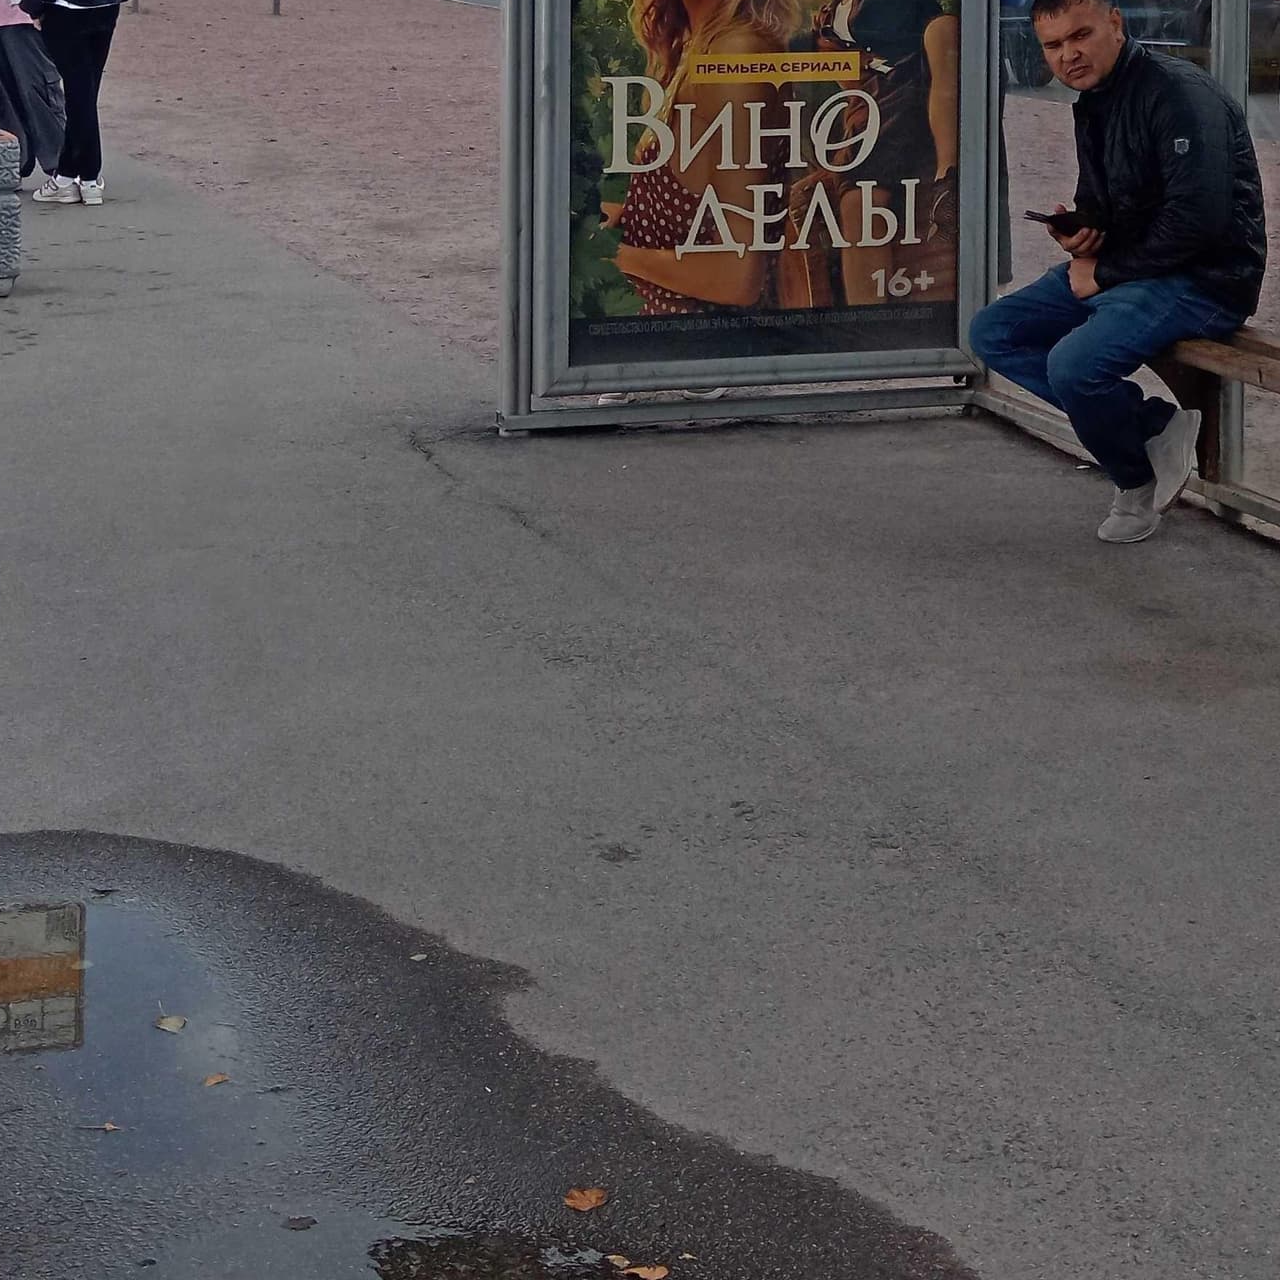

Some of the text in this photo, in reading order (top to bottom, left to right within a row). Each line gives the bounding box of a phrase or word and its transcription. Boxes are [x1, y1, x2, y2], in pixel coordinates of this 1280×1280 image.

[695, 60, 853, 76] ПРЕМЬЕРА СЕРИАЛА
[674, 178, 922, 261] ДЕЛЫ
[871, 267, 936, 297] 16+
